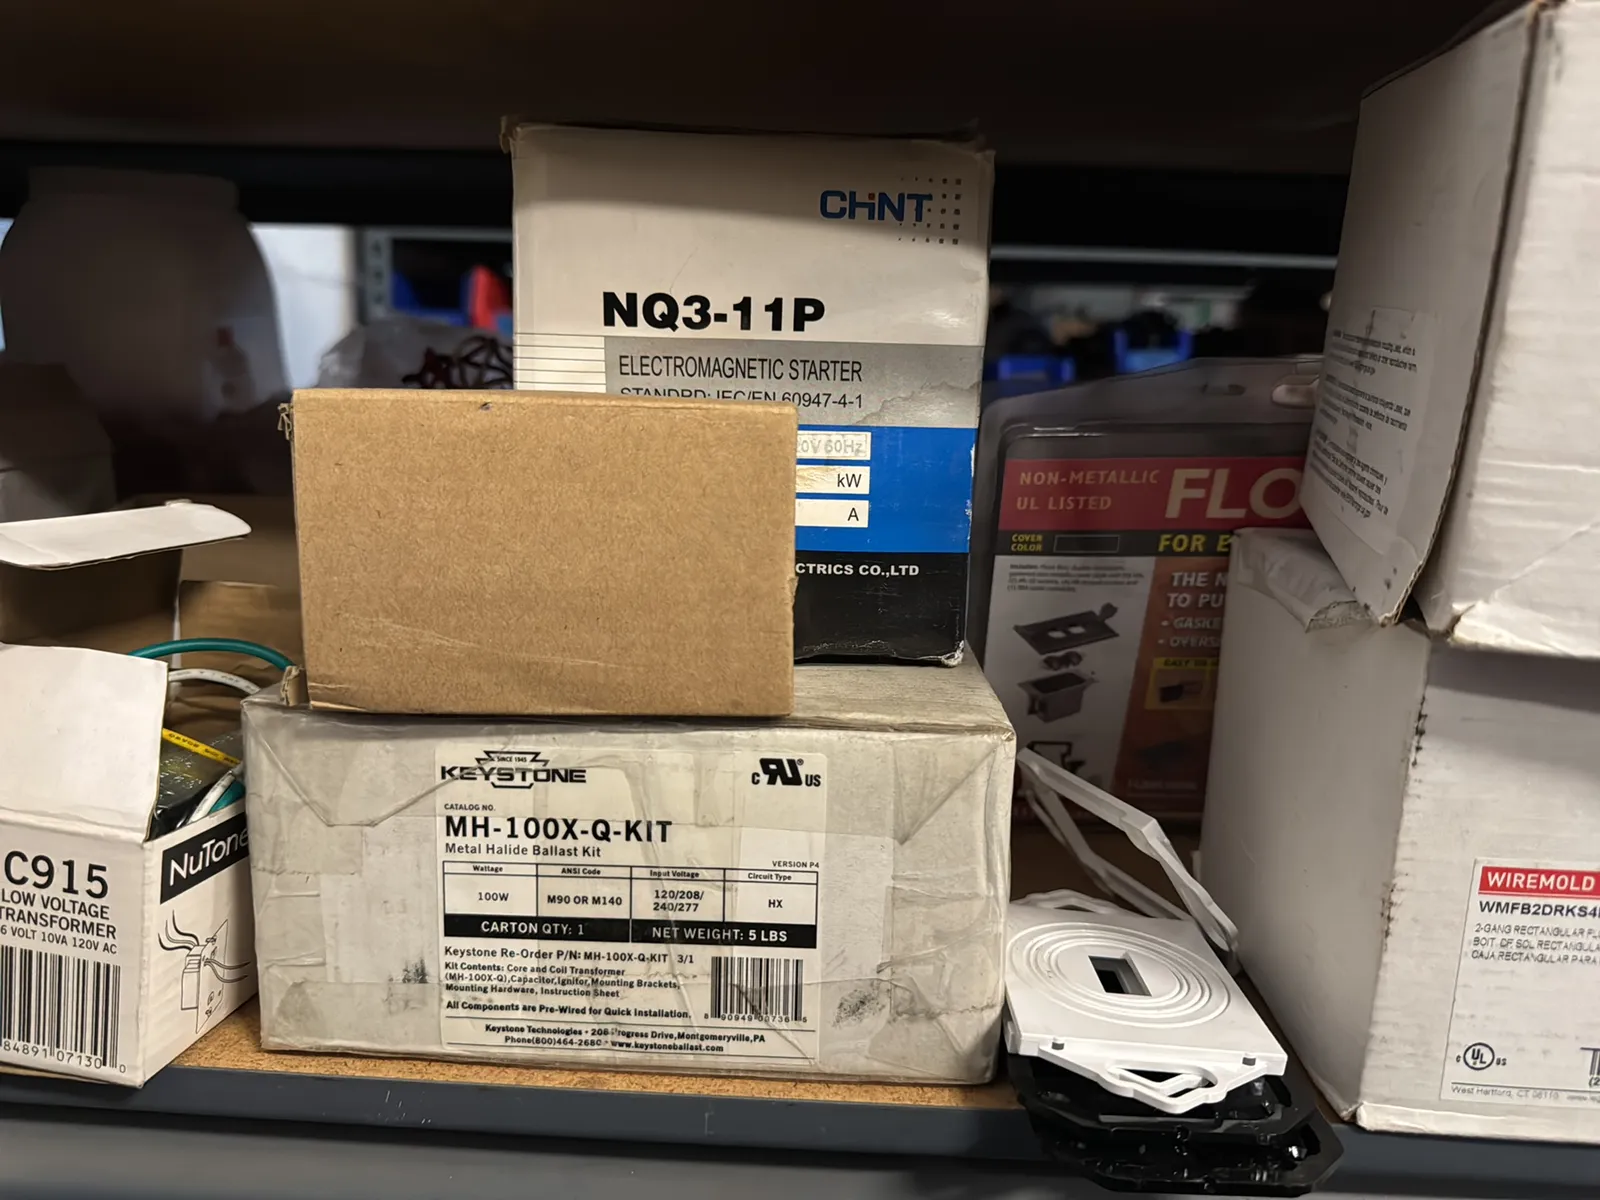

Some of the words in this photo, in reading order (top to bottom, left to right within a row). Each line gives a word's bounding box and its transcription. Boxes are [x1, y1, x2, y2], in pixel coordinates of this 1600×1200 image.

[602, 291, 826, 332] NQ3-11P
[619, 355, 784, 380] ELECTROMAGNETIC
[788, 358, 862, 381] STARTER
[782, 391, 862, 409] 60947-4-1
[797, 439, 821, 454] 0V
[824, 439, 863, 456] 60Hz
[837, 473, 862, 488] kW
[1019, 469, 1161, 486] NON-METALLIC
[1016, 496, 1038, 510] UL
[1048, 495, 1113, 511] LISTED
[847, 507, 859, 522] A
[1011, 533, 1043, 543] COVER
[1158, 534, 1206, 552] FOR
[1010, 543, 1043, 552] COLOR
[858, 564, 920, 578] CO.,LTD
[1171, 571, 1209, 587] THE
[1167, 593, 1191, 608] TO
[440, 765, 587, 784] KEYSTONE
[444, 803, 480, 812] CATALOG
[445, 815, 672, 843] MH-100X-Q-KIT
[445, 843, 482, 854] Metal
[486, 844, 528, 856] Halide
[532, 845, 578, 857] Ballast
[582, 846, 601, 857] Kit
[169, 830, 249, 886] NuTone
[772, 860, 807, 868] VERSION
[4, 850, 108, 900] C915
[472, 865, 503, 873] Wattage
[650, 870, 670, 878] Input
[671, 871, 700, 879] Voltage
[748, 873, 773, 881] Circuit
[774, 874, 792, 882] Type
[1487, 872, 1595, 891] WIREMOLD
[478, 892, 509, 901] 100W
[547, 895, 571, 904] M90
[573, 896, 589, 905] OR
[592, 897, 623, 906] M140
[654, 890, 705, 901] 120/208/
[2, 888, 36, 907] LOW
[40, 894, 110, 920] VOLTAGE
[653, 902, 699, 912] 240/277
[768, 899, 783, 908] HX
[1479, 901, 1600, 918] WMFB2DRKS4
[0, 906, 116, 939] TRANSFORMER
[481, 921, 538, 934] CARTON
[542, 923, 572, 935] QTY:
[578, 925, 585, 935] 1
[1475, 923, 1512, 934] 2-GANG
[11, 926, 37, 940] VOLT
[41, 931, 68, 946] 10VA
[72, 937, 99, 951] 120V
[103, 942, 117, 955] AC
[652, 928, 679, 939] NET
[684, 929, 743, 941] WEIGHT:
[748, 930, 756, 941] 5
[761, 931, 788, 942] LBS
[444, 946, 497, 958] Keystone
[501, 947, 553, 959] Re-Order
[556, 949, 581, 960] P/N:
[584, 950, 668, 963] MH-100X-Q-KIT
[677, 954, 694, 964] 3/1
[1472, 950, 1495, 961] CAJA
[445, 962, 458, 970] Kit
[460, 962, 504, 972] Contents:
[507, 964, 527, 972] Core
[530, 965, 547, 973] and
[549, 965, 567, 974] Coil
[569, 966, 625, 976] Transformer
[445, 984, 488, 994] Mounting
[490, 985, 538, 995] Hardware,
[541, 987, 591, 997] Instruction
[593, 988, 620, 998] Sheet
[637, 979, 681, 990] Brackets,
[446, 1001, 459, 1009] All
[461, 1002, 520, 1012] Components
[522, 1004, 537, 1012] are
[539, 1004, 586, 1015] Pre-Wired
[589, 1007, 602, 1015] for
[604, 1007, 632, 1016] Quick
[485, 1024, 525, 1033] Keystone
[527, 1025, 582, 1036] Technologies
[611, 1041, 724, 1052] www.keystoneballast.com
[3, 1040, 48, 1059] 84891
[56, 1050, 102, 1069] 07130
[119, 1064, 126, 1073] 0
[1451, 1085, 1474, 1095] West
